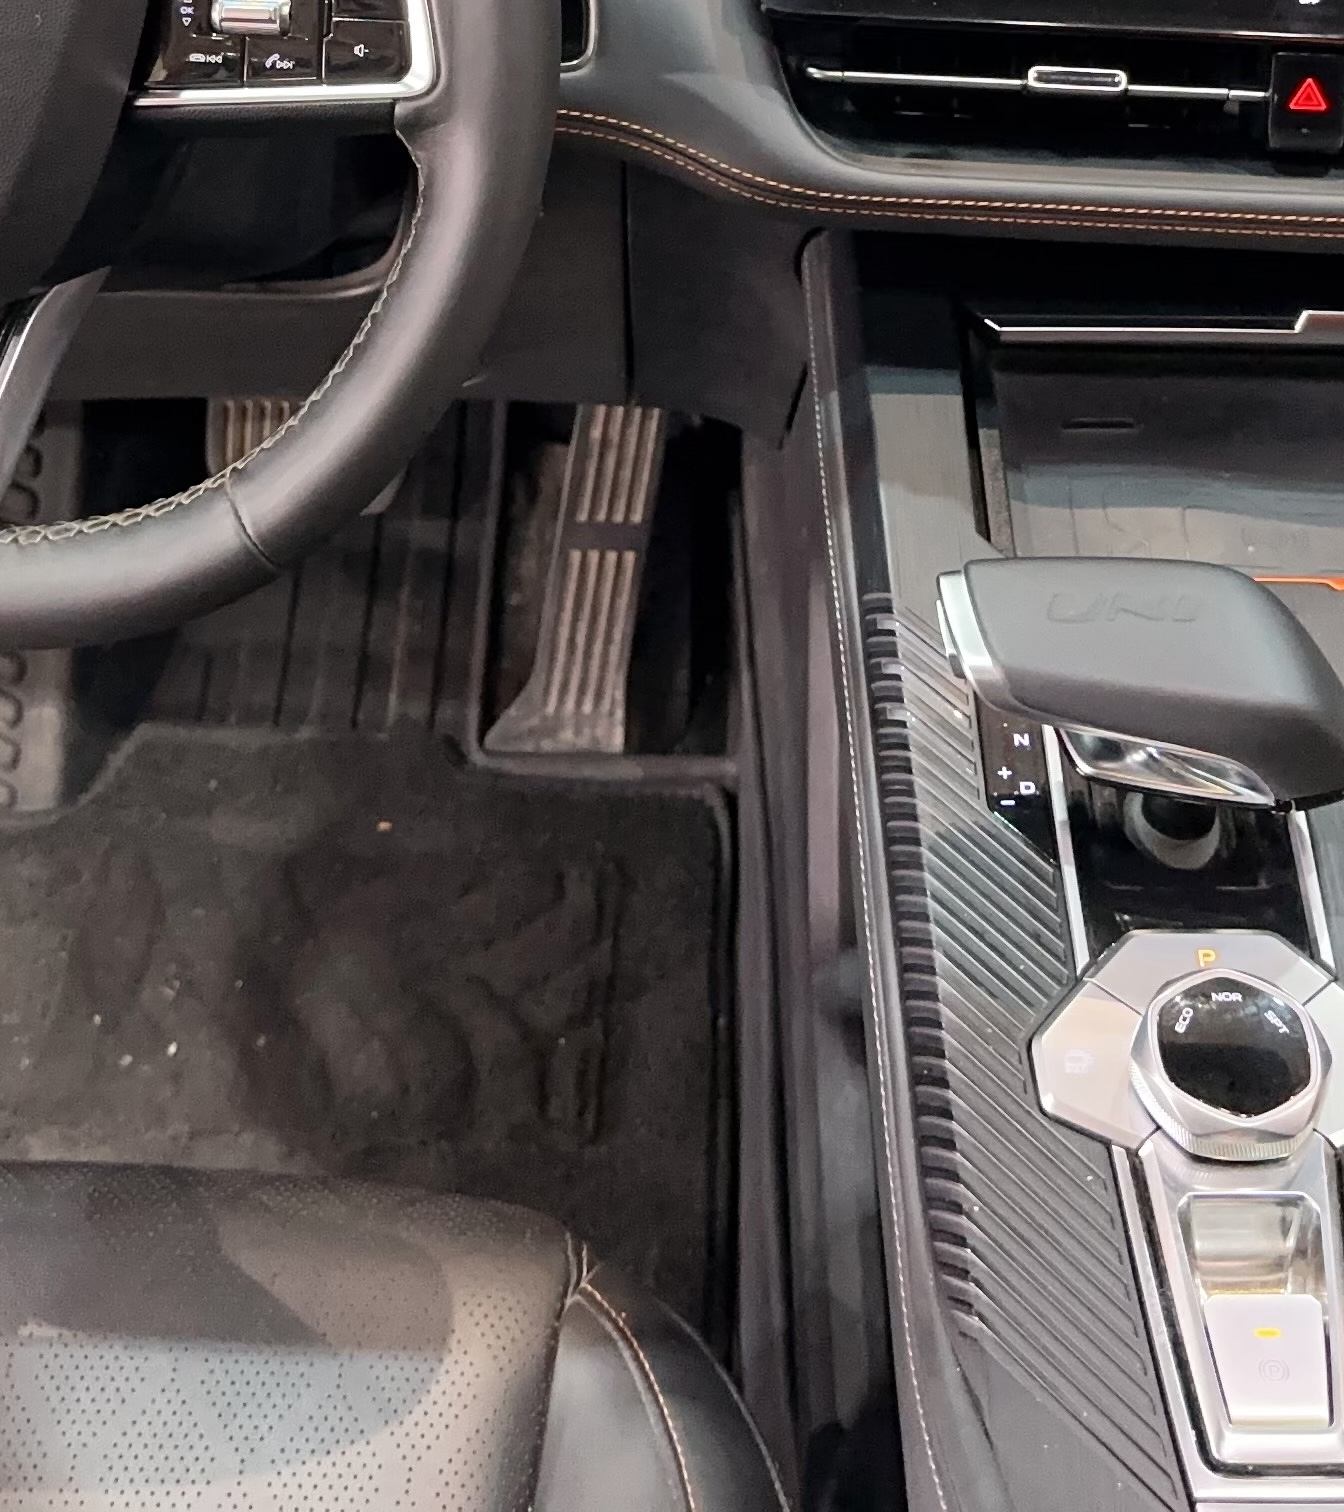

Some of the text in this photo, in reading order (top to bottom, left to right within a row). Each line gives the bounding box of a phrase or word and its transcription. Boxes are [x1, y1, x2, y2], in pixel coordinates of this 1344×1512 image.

[180, 5, 194, 15] OK
[1013, 732, 1031, 748] N
[1018, 780, 1037, 795] D
[1197, 948, 1217, 968] P
[1211, 991, 1243, 1004] NOR
[1174, 1007, 1194, 1035] ECO
[1263, 1009, 1290, 1036] SPT
